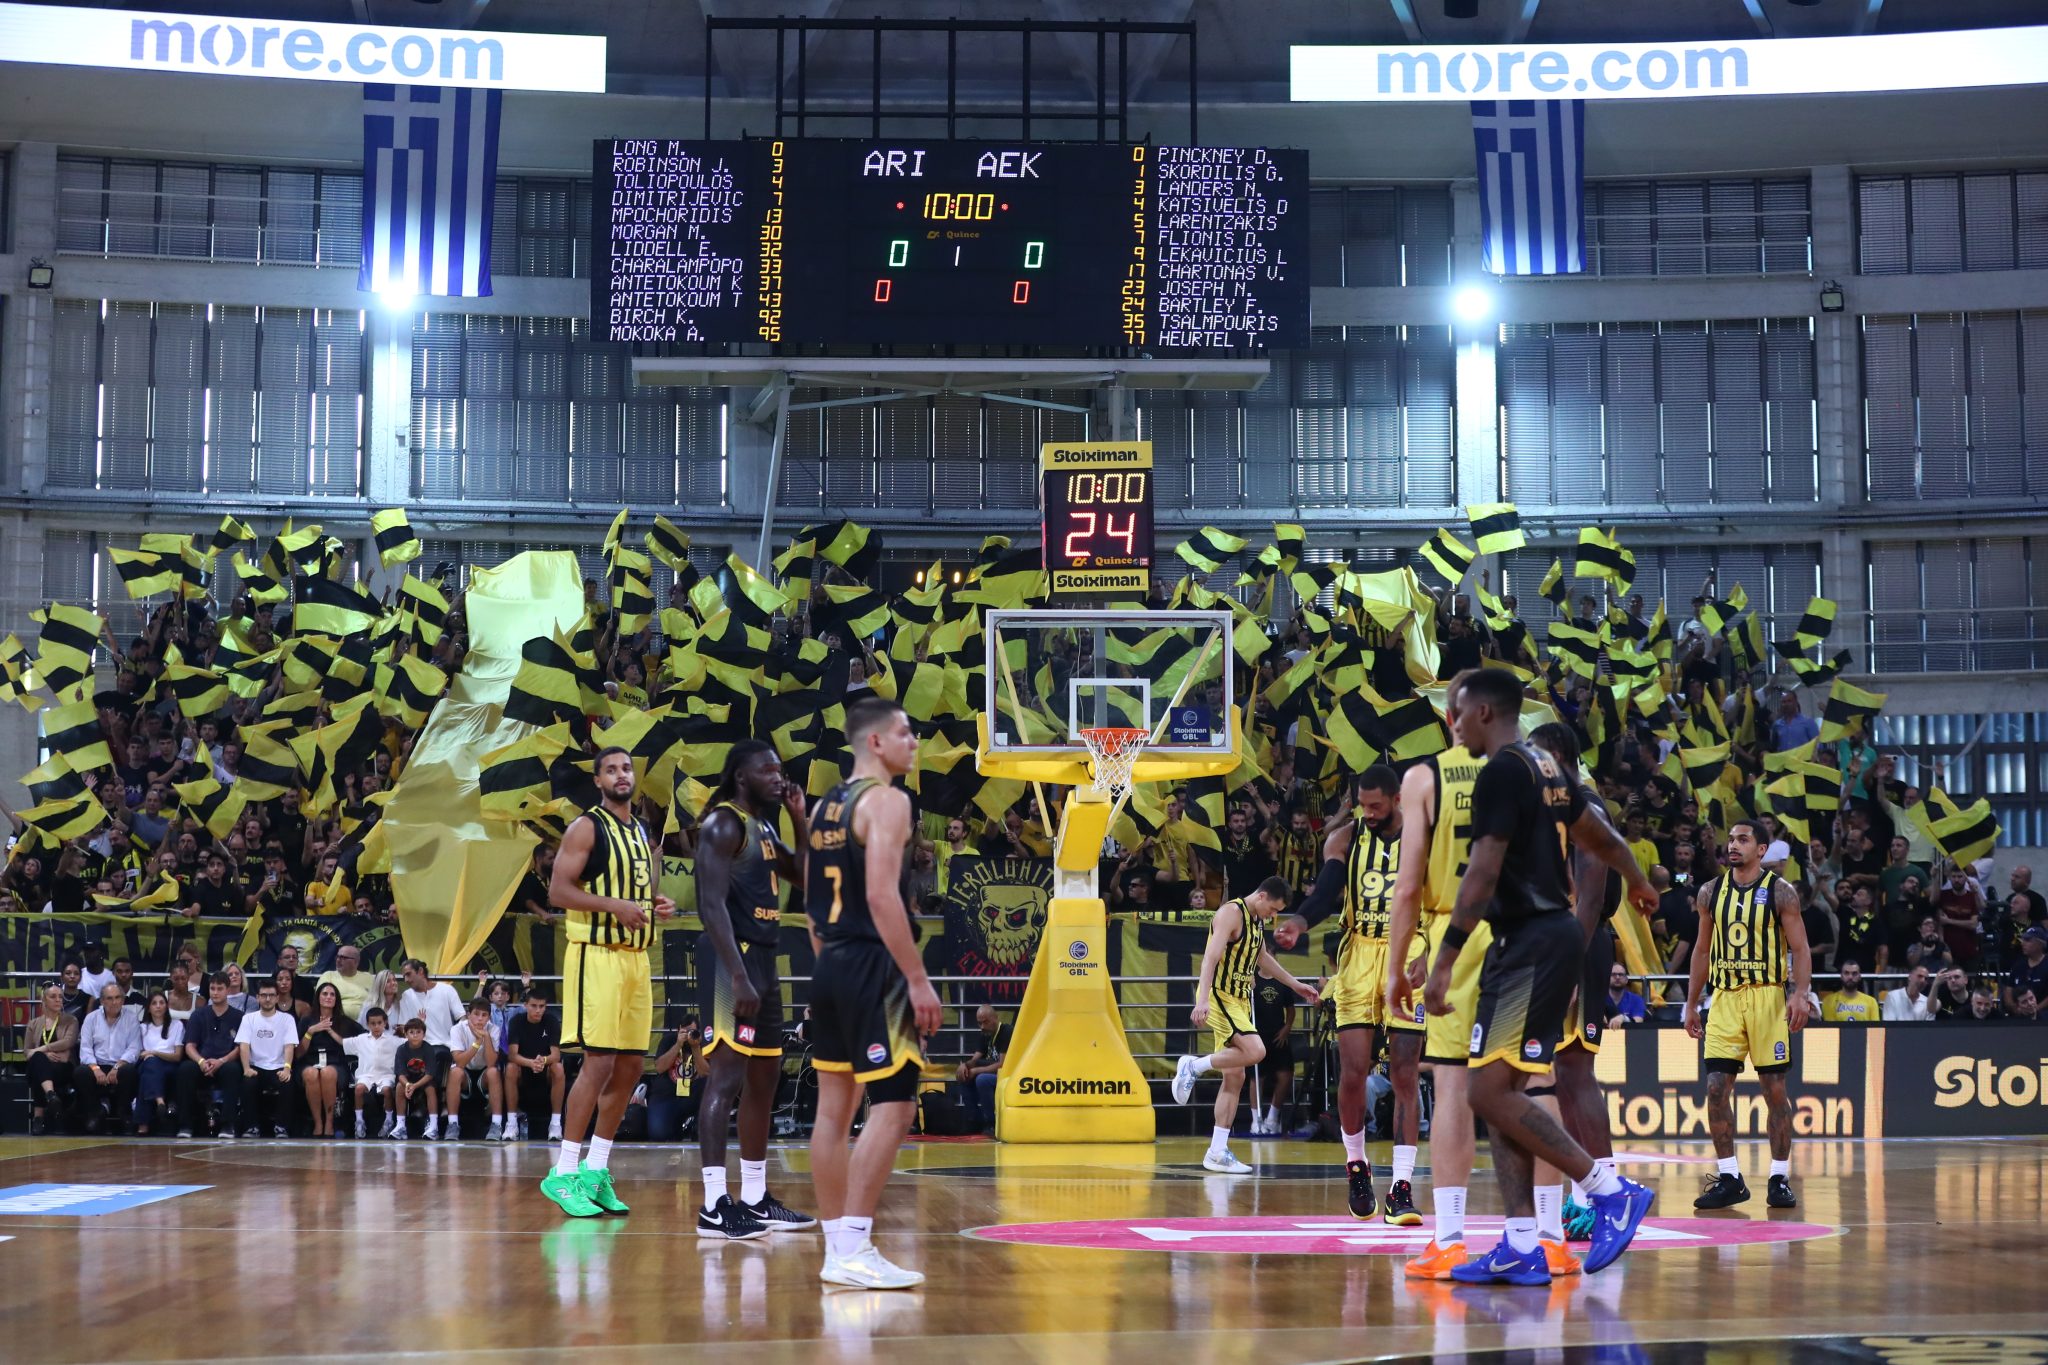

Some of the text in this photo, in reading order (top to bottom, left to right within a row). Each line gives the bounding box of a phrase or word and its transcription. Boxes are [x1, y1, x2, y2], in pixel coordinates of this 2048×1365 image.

[130, 19, 504, 81] more.com
[1376, 46, 1750, 95] more.com
[613, 141, 783, 157] LONG M. 0
[1133, 147, 1272, 164] 0 PINCKNEY D.
[613, 157, 783, 174] ROBINSON J. 3
[864, 150, 1042, 178] ARI AEK
[1140, 164, 1283, 181] 1 SKORDILIS G.
[615, 173, 783, 189] TOLIOPOULOS 4
[1134, 180, 1261, 198] 3 LANDERS N.
[612, 190, 782, 207] DIMITRIJEVIC 7
[924, 193, 994, 220] 10:00
[1134, 197, 1288, 215] 4 KATSIVELIS D
[612, 207, 782, 223] MPOCHORIDIS 13
[1134, 213, 1279, 231] 5 LARENTZAKIS
[612, 224, 782, 240] MORGAN M. 30
[1136, 230, 1262, 247] 7 FLIONIS D.
[611, 241, 782, 258] LIDDELL E. 32
[889, 240, 1044, 268] 0 1 0
[1134, 247, 1287, 265] 9 LEKAVICIUS L
[611, 258, 781, 274] CHARALAMPOPO 33
[1129, 263, 1284, 281] 17 CHARTONAS V.
[611, 275, 781, 290] ANTETOKOUM K 37
[1122, 280, 1251, 297] 23 JOSEPH N.
[610, 292, 781, 307] ANTETOKOUM T 43
[875, 280, 1029, 303] 0 0
[1122, 297, 1262, 314] 24 BARTLEY F.
[610, 308, 781, 324] BIRCH K. 92
[1123, 313, 1278, 332] 35 TSALMPOURIS
[610, 325, 780, 341] MOKOKA A. 95
[1124, 330, 1263, 347] 77 HEURTEL T.
[1054, 450, 1138, 463] Stoiximan
[1067, 473, 1145, 504] 10:00
[1065, 512, 1136, 557] 24
[1095, 556, 1132, 567] Quince
[1056, 575, 1141, 588] Stoiximan
[633, 859, 651, 887] 3
[824, 866, 842, 924] 7
[1728, 921, 1749, 948] 0
[1069, 968, 1088, 976] GBL
[1019, 1077, 1131, 1095] Stoiximan
[1602, 1088, 1854, 1137] toixman
